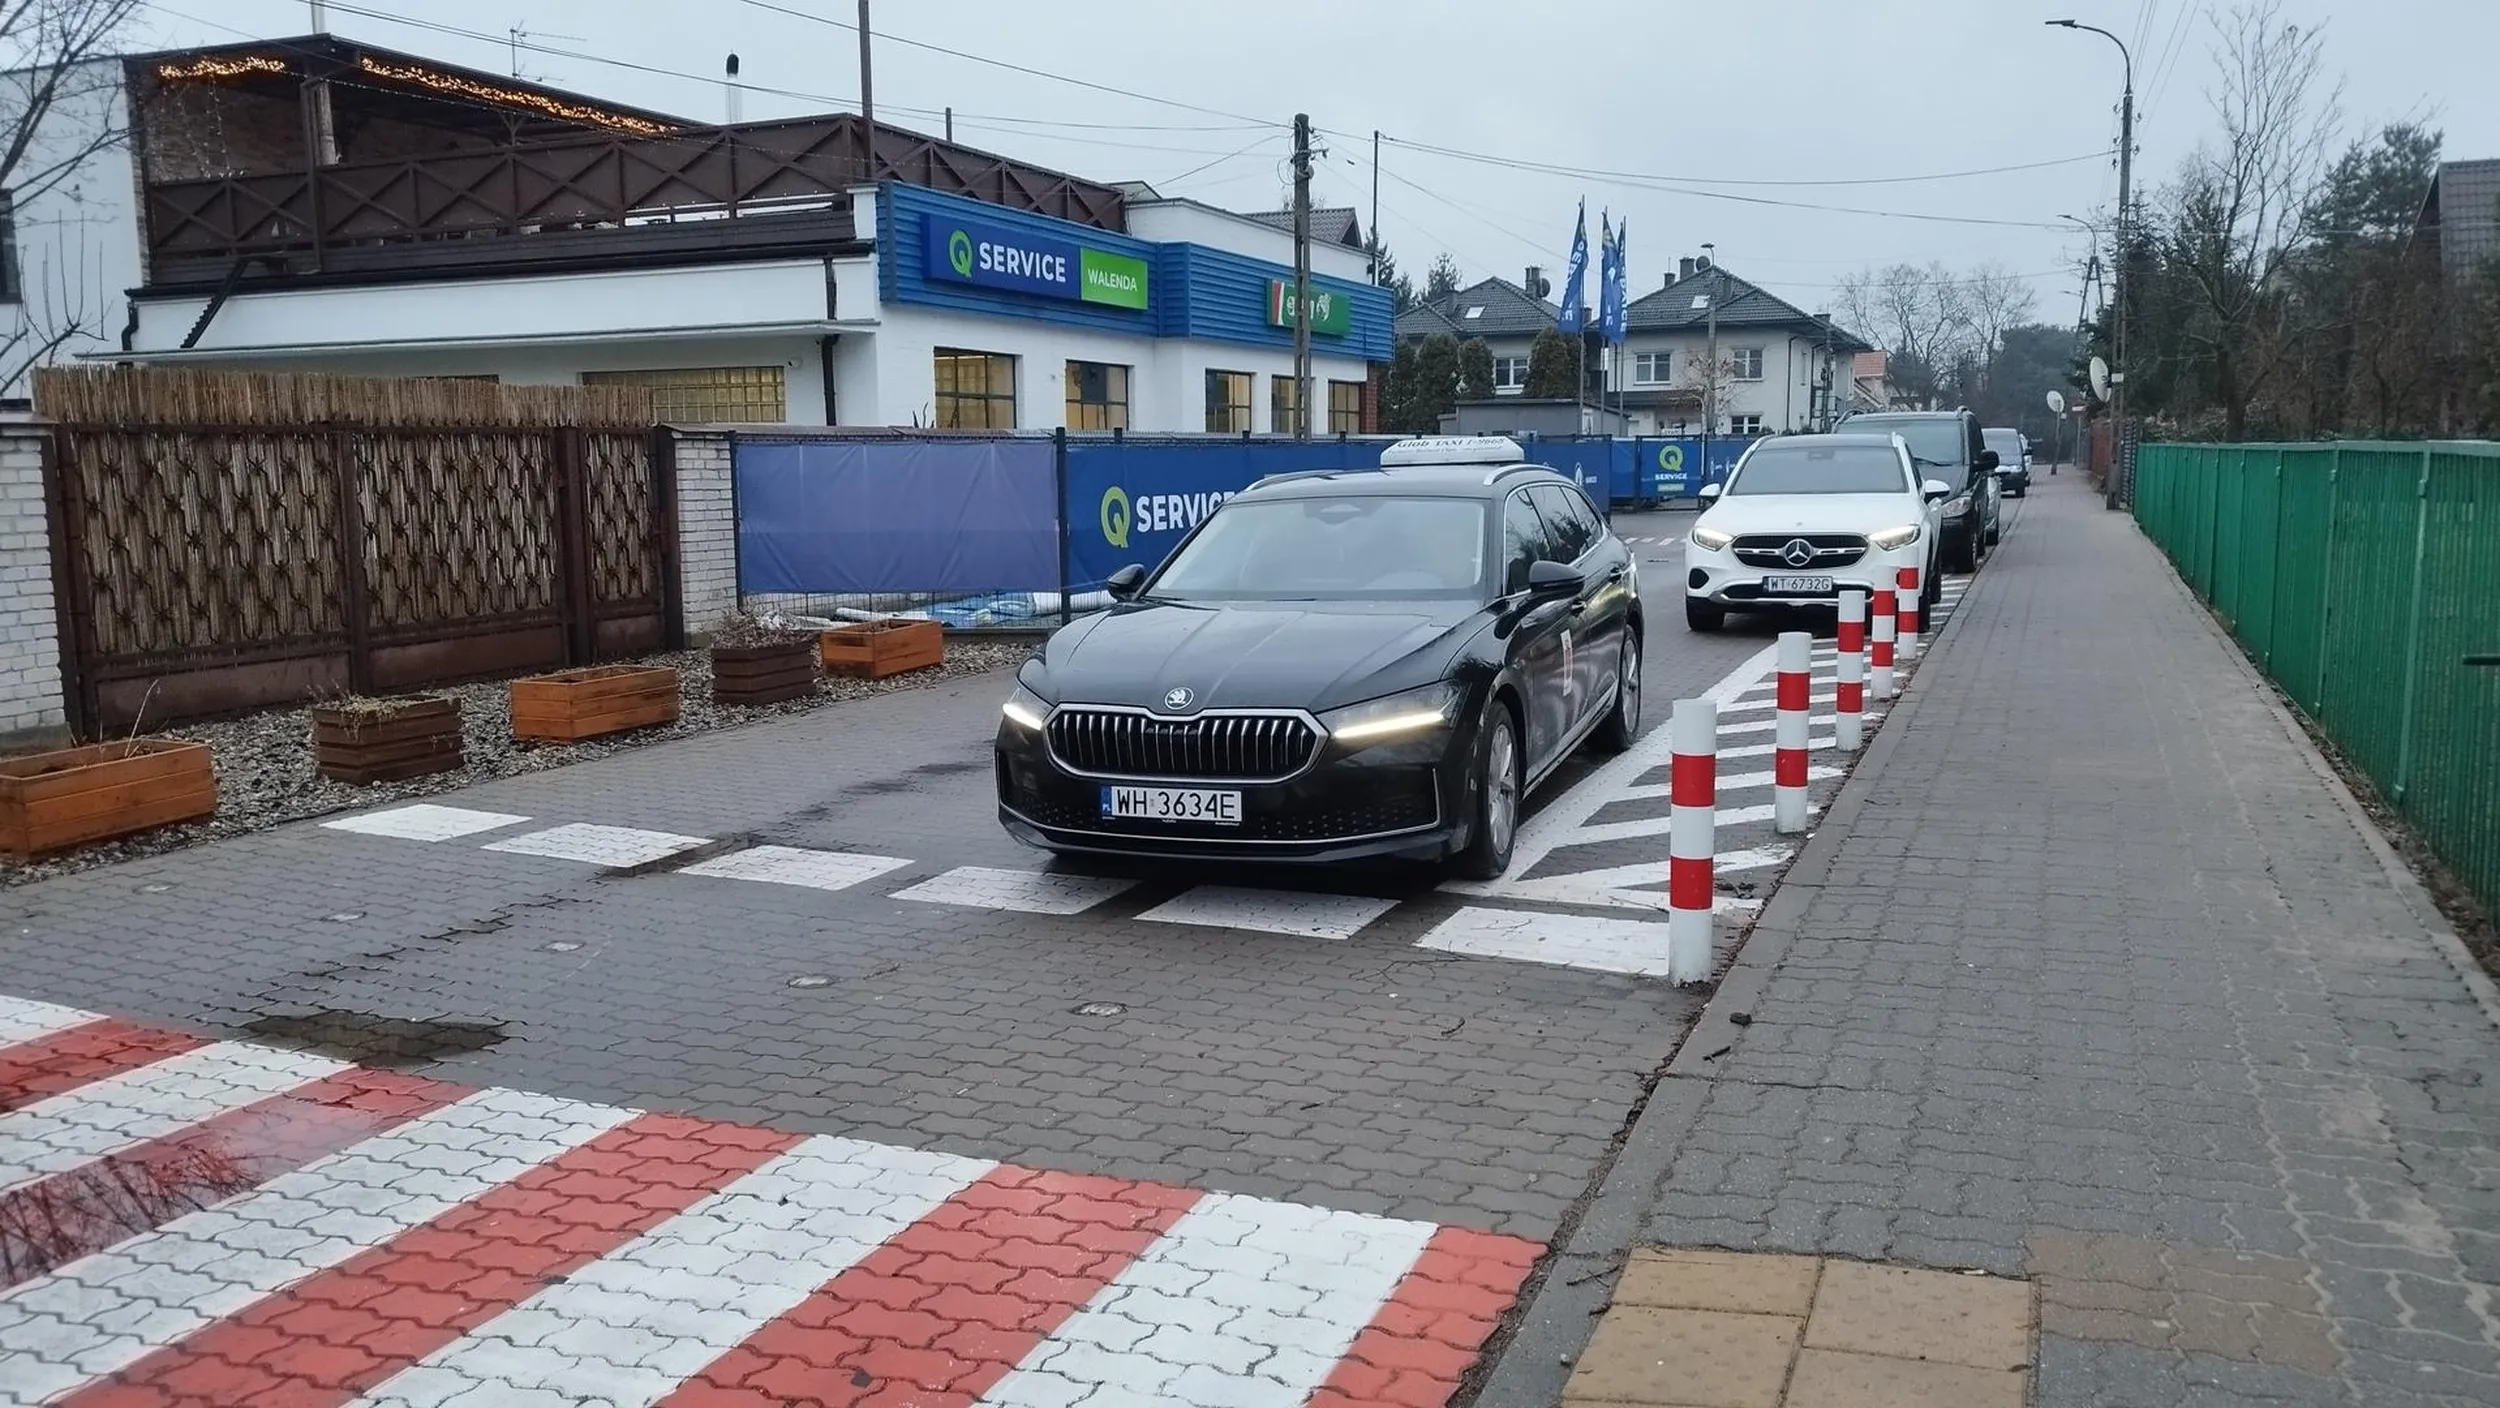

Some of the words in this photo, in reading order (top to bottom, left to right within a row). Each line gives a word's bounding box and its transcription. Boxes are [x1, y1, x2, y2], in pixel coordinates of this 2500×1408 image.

[949, 229, 973, 278] Q
[979, 242, 1066, 283] SERVICE
[1087, 269, 1138, 292] WALENDA
[1435, 439, 1463, 447] TAXI
[1659, 445, 1683, 471] Q
[1655, 472, 1687, 480] SERVICE
[1101, 486, 1130, 548] Q
[1136, 491, 1236, 532] SERVIC
[1770, 578, 1786, 589] WT
[1791, 578, 1829, 590] 6732G
[1117, 789, 1147, 815] WH
[1158, 791, 1235, 819] 3634E
